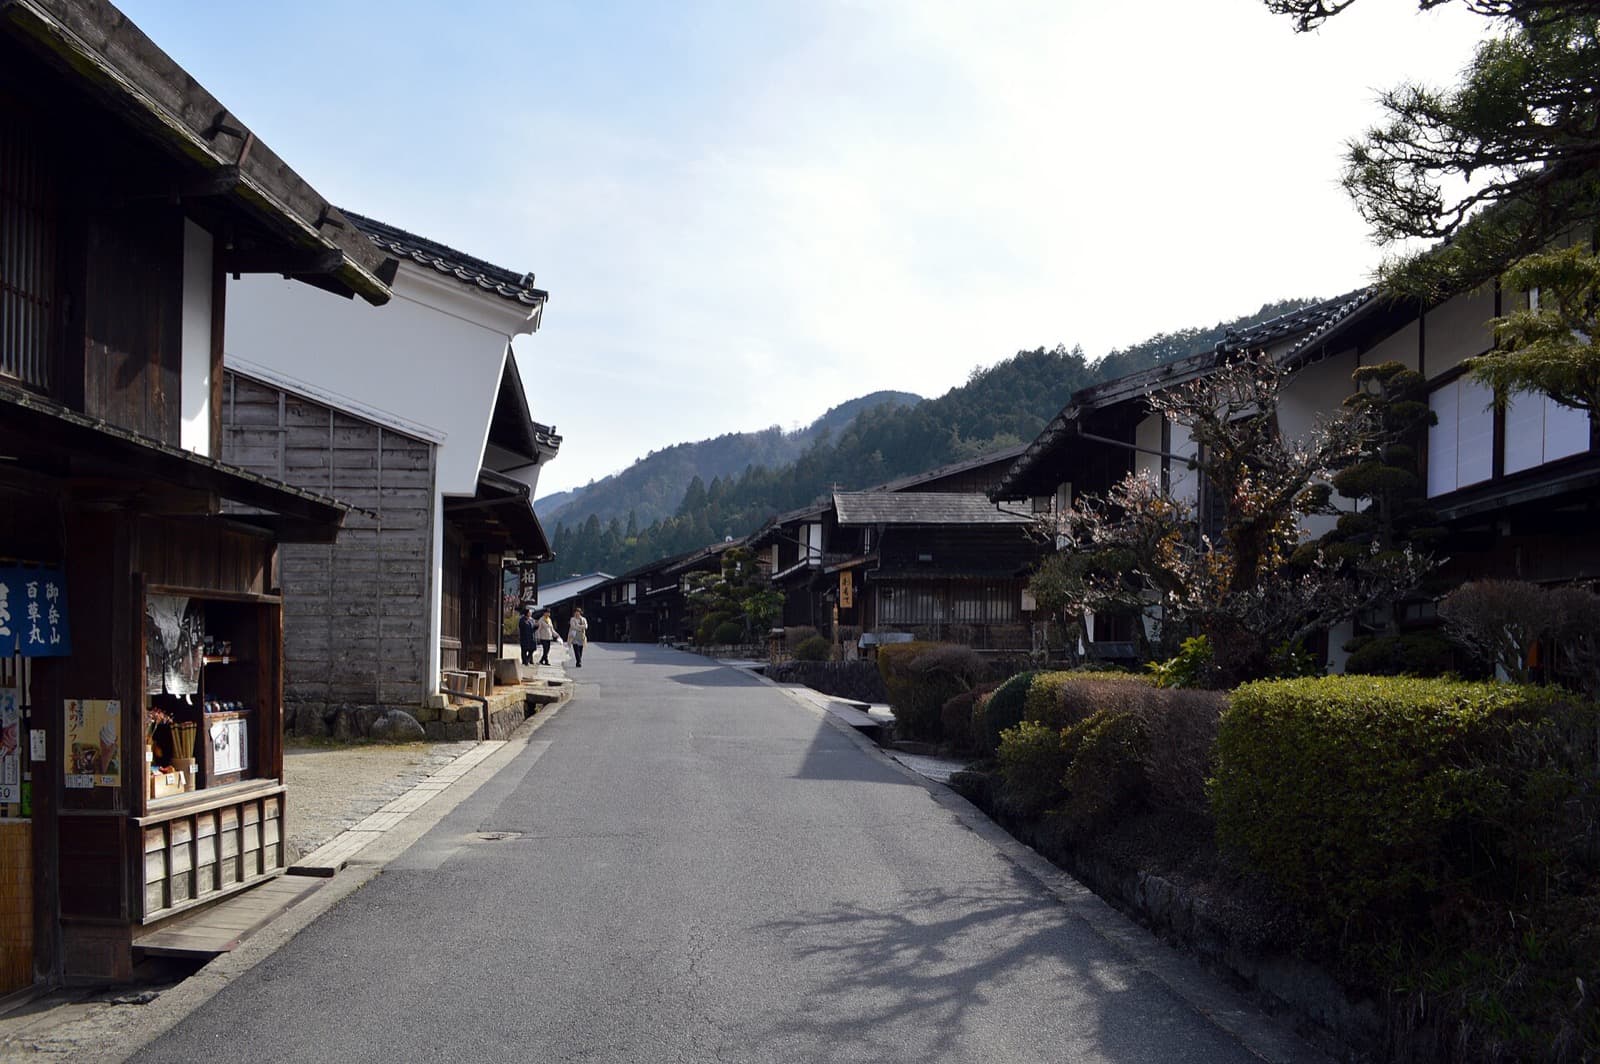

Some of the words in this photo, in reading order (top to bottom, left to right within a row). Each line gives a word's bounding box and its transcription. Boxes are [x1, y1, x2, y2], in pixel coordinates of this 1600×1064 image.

[26, 581, 45, 644] 百草丸
[46, 582, 61, 645] 御岳山
[521, 568, 536, 602] 柏屋
